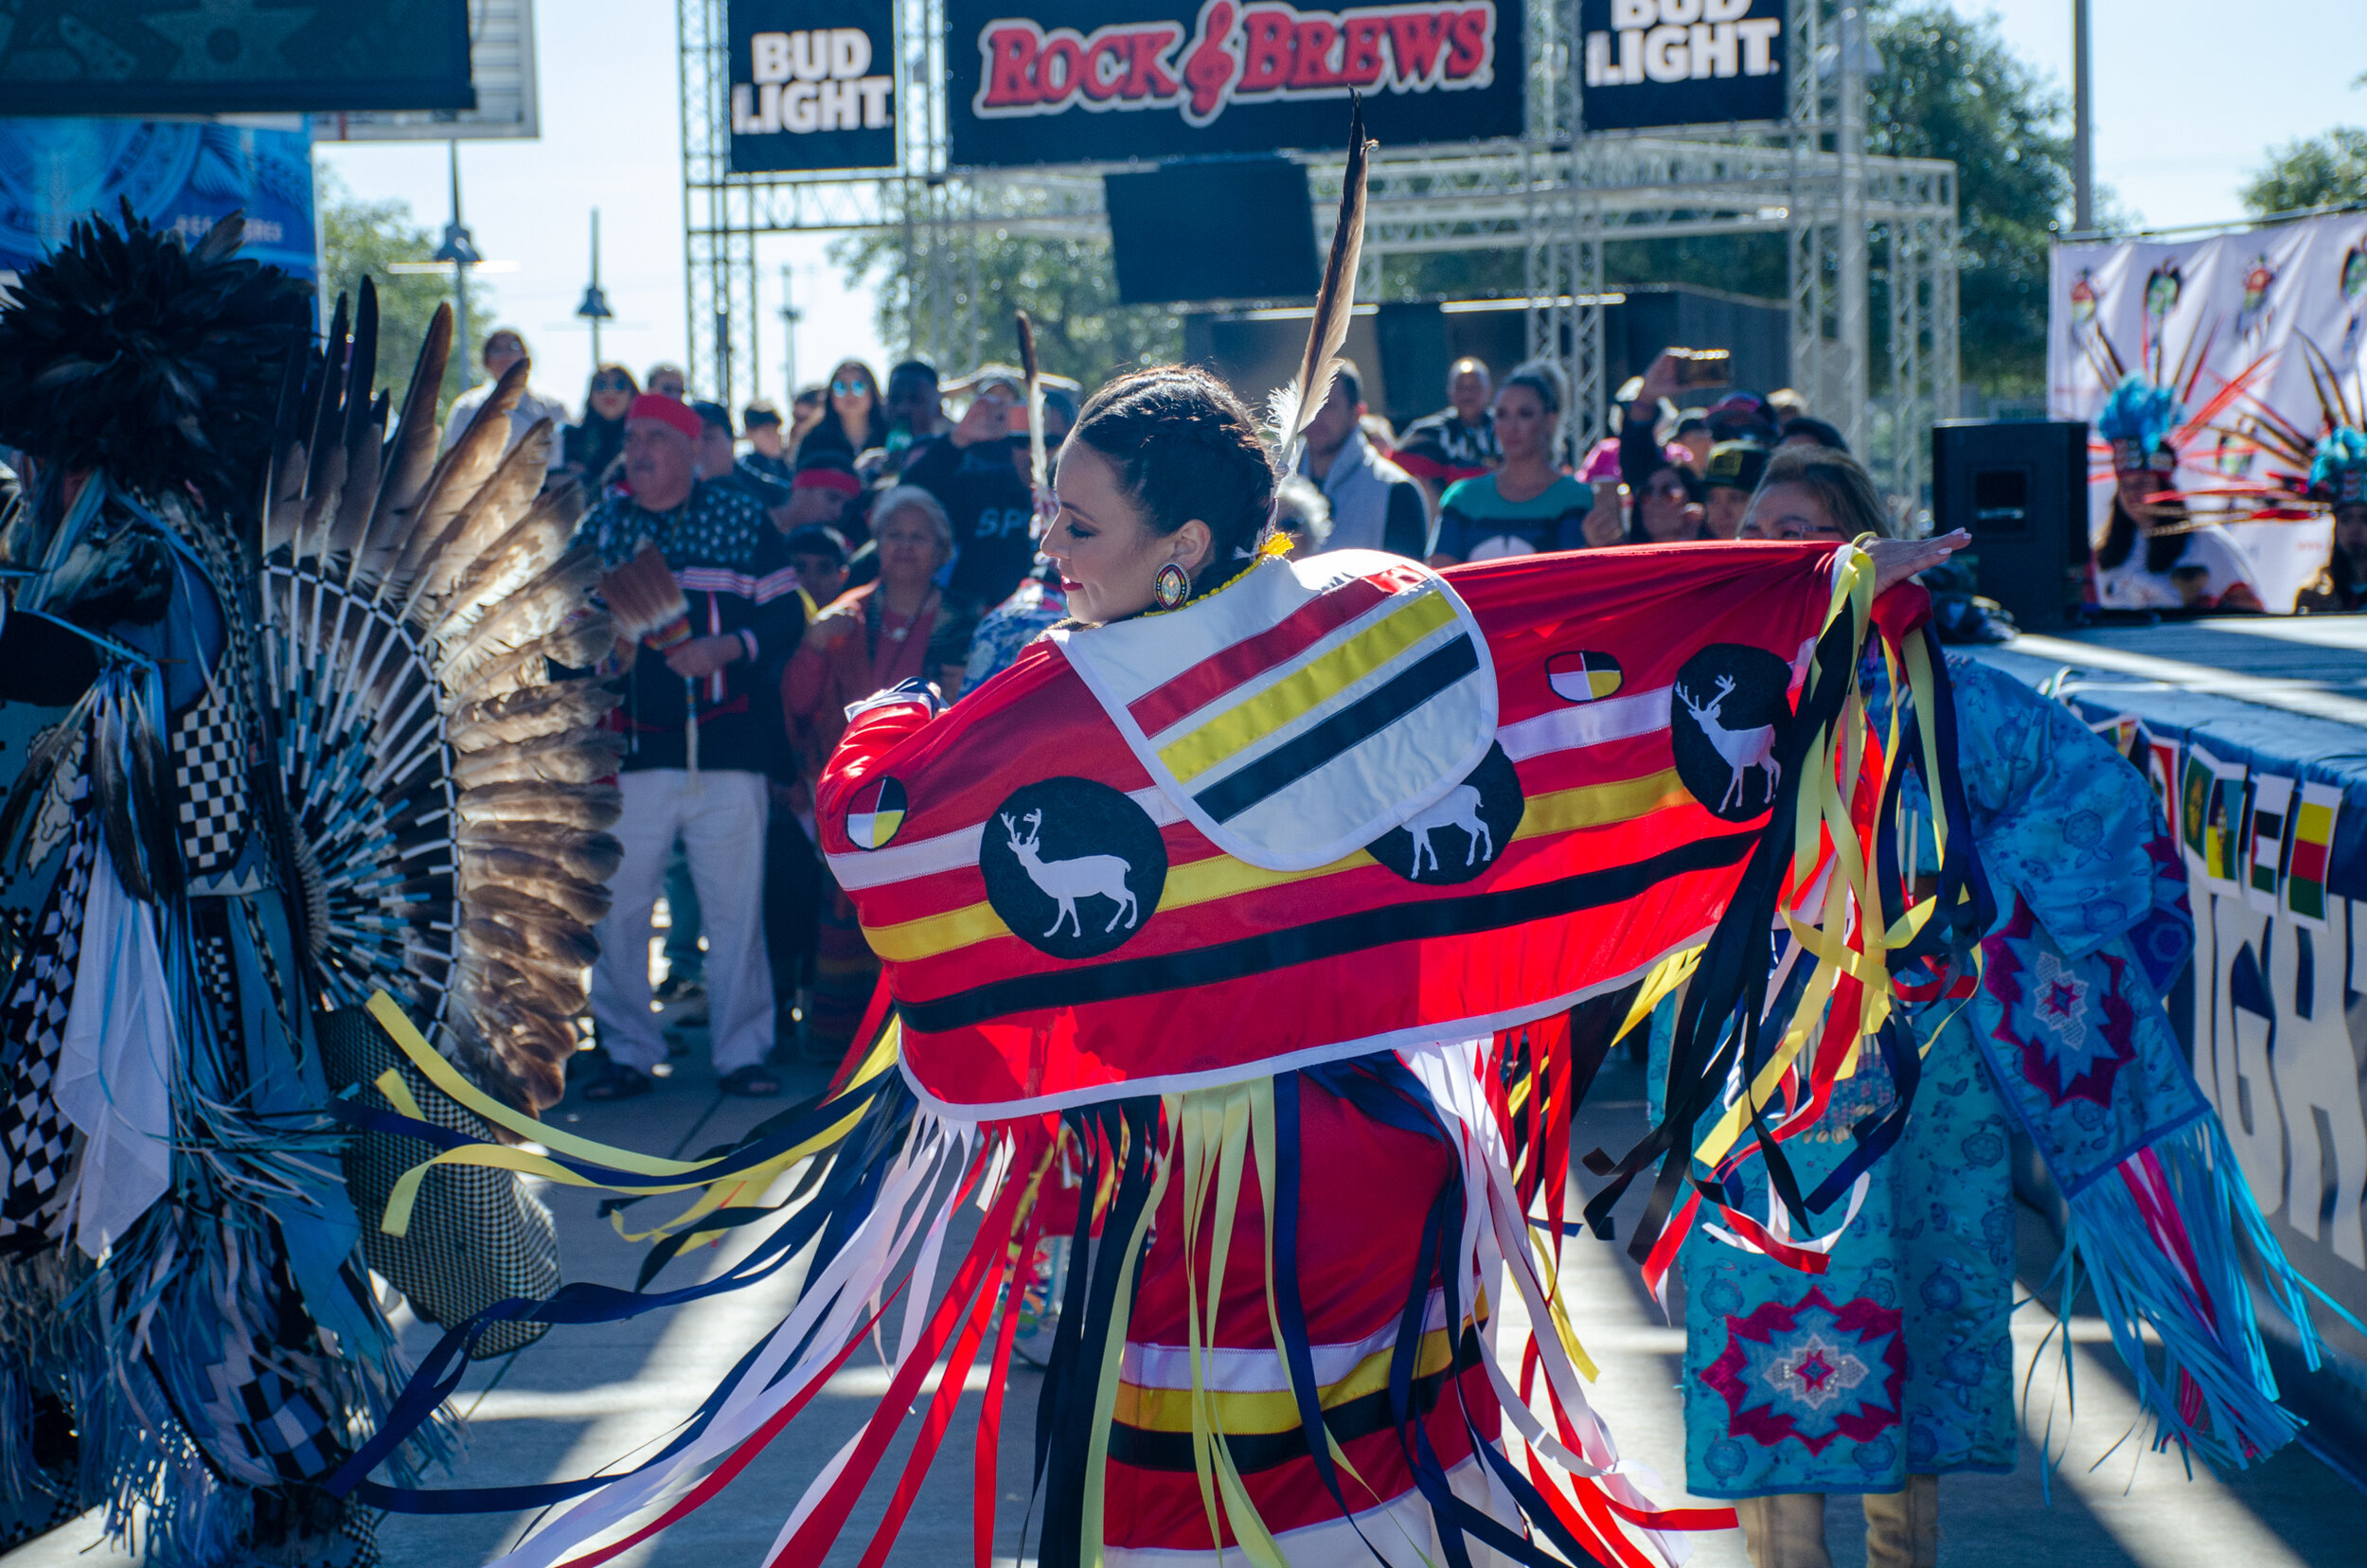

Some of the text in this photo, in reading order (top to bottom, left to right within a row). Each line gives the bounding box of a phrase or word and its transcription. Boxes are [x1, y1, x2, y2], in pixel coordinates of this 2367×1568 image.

[752, 28, 872, 84] BUD
[975, 20, 1184, 117] ROCK
[1224, 3, 1494, 101] BREWS
[1585, 17, 1780, 87] LIGHT
[732, 76, 894, 134] LIGHT
[974, 508, 1032, 538] SP
[2186, 871, 2367, 1271] IGH
